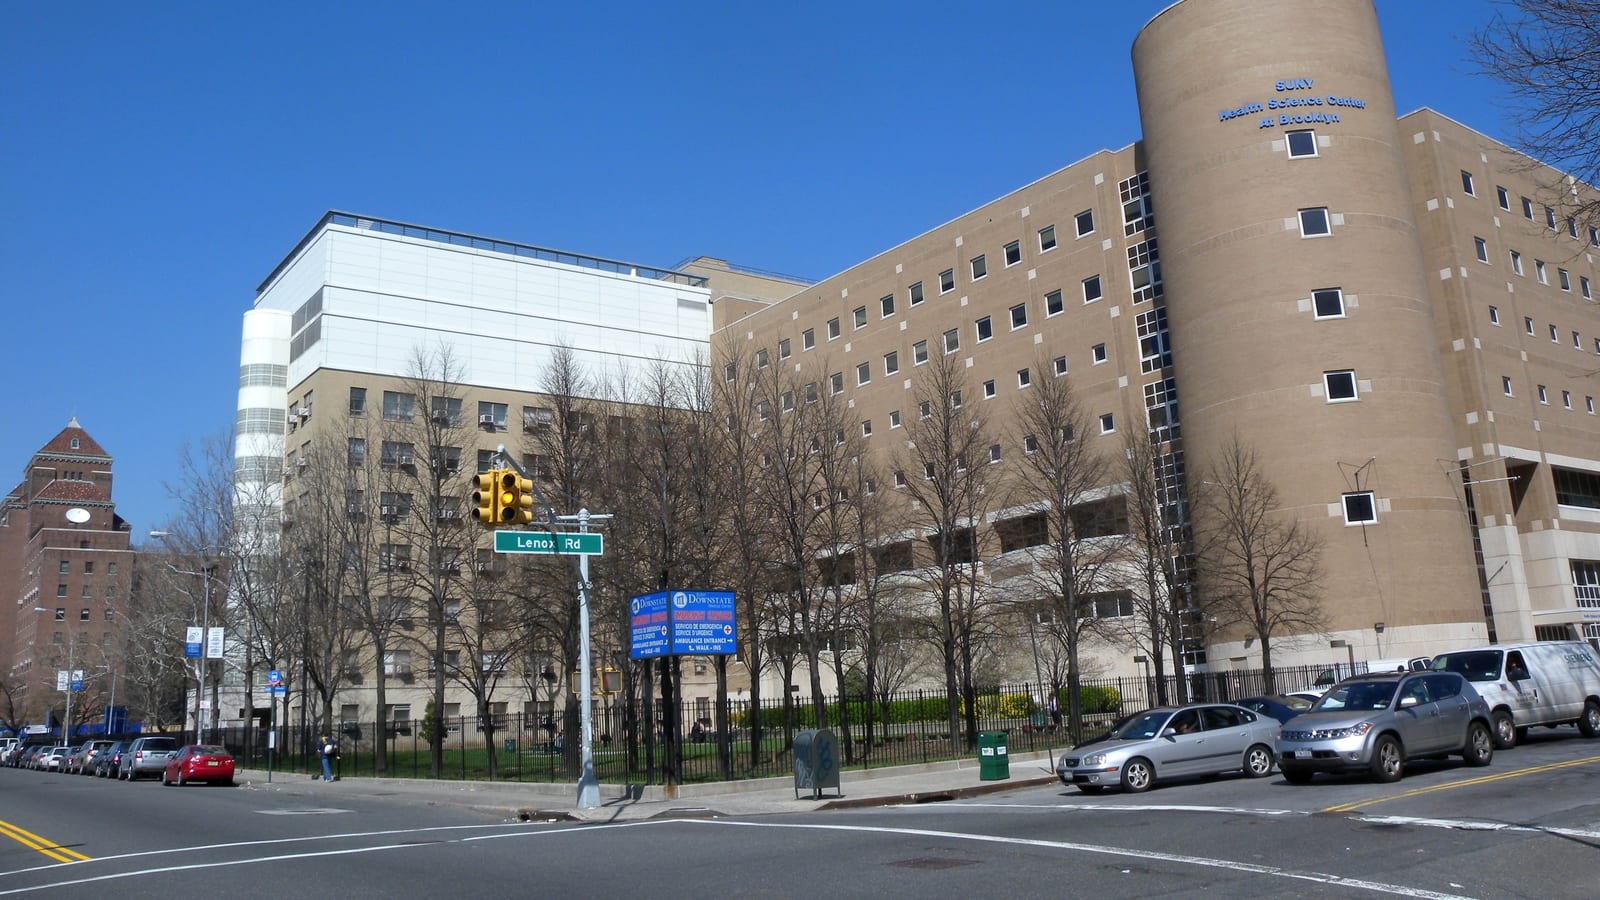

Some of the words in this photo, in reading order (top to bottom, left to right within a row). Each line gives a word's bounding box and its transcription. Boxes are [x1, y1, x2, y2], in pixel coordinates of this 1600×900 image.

[1275, 79, 1313, 91] SUNY
[1218, 102, 1264, 121] Health
[1268, 95, 1323, 110] Science
[1326, 95, 1367, 109] Center
[1259, 117, 1275, 128] At
[1279, 111, 1341, 126] Brooklyn
[517, 537, 556, 549] Lenox
[565, 538, 581, 549] Rd
[1564, 653, 1593, 664] SIEMENS
